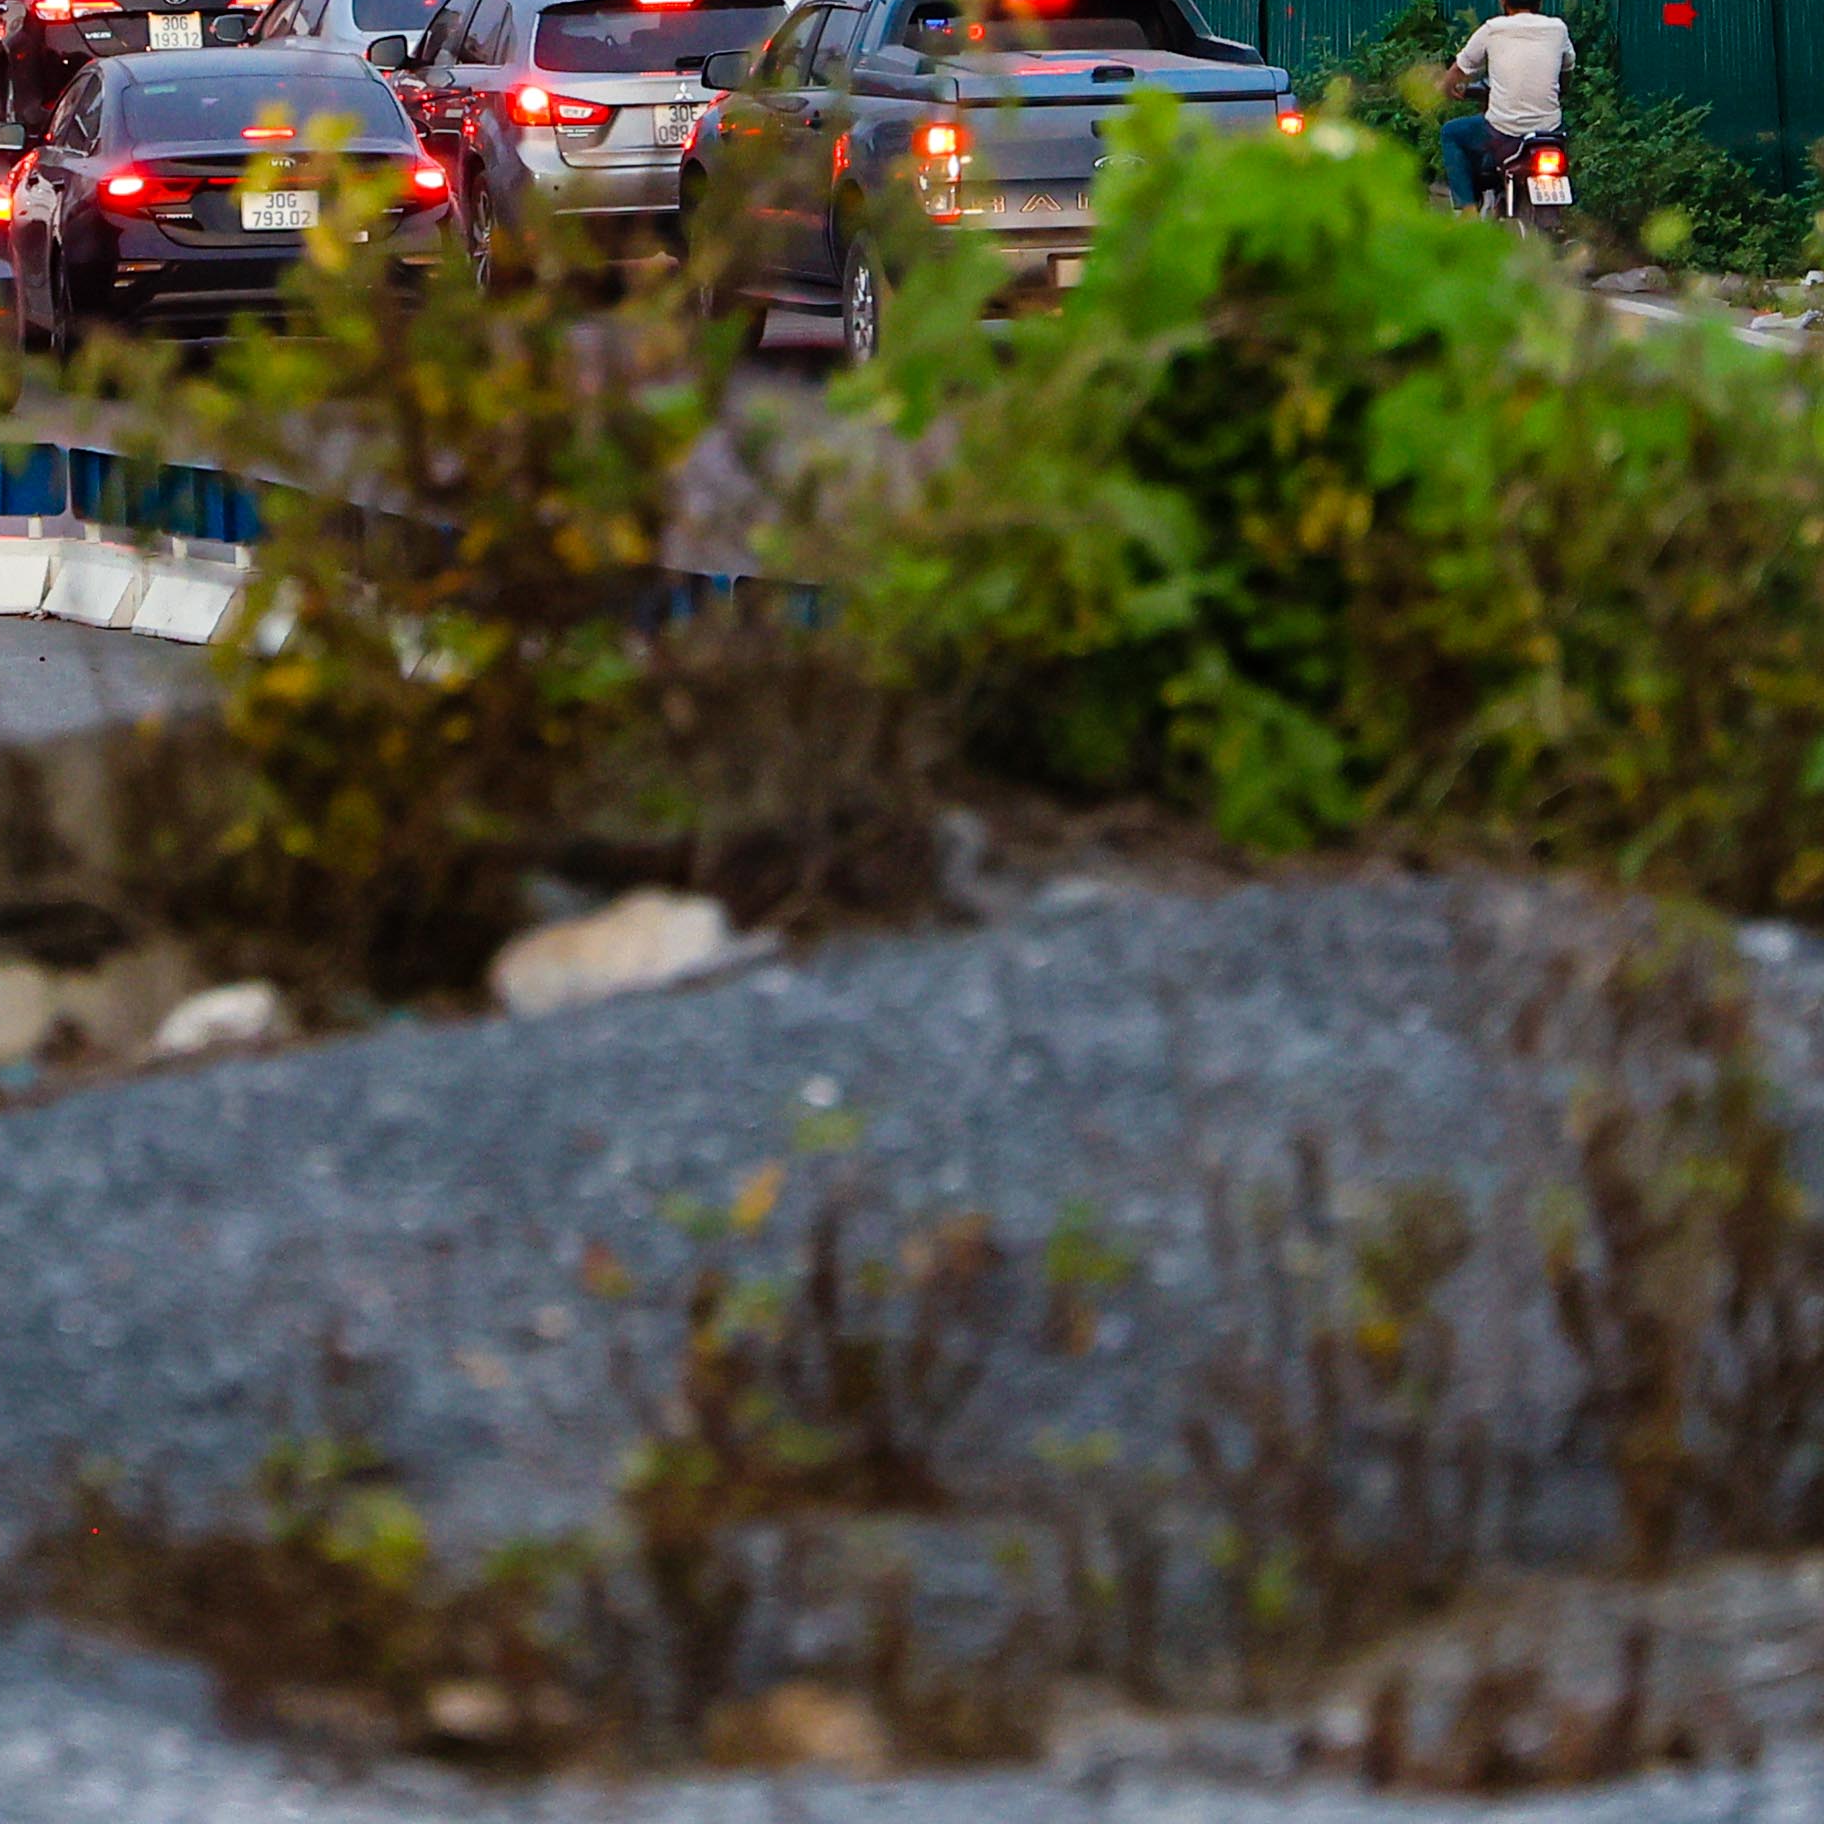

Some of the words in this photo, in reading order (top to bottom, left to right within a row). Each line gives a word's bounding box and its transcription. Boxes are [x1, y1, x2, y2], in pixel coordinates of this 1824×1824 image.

[161, 15, 189, 31] 30G
[155, 32, 200, 48] 193.12
[265, 192, 297, 209] 30G
[252, 210, 311, 227] 793.02
